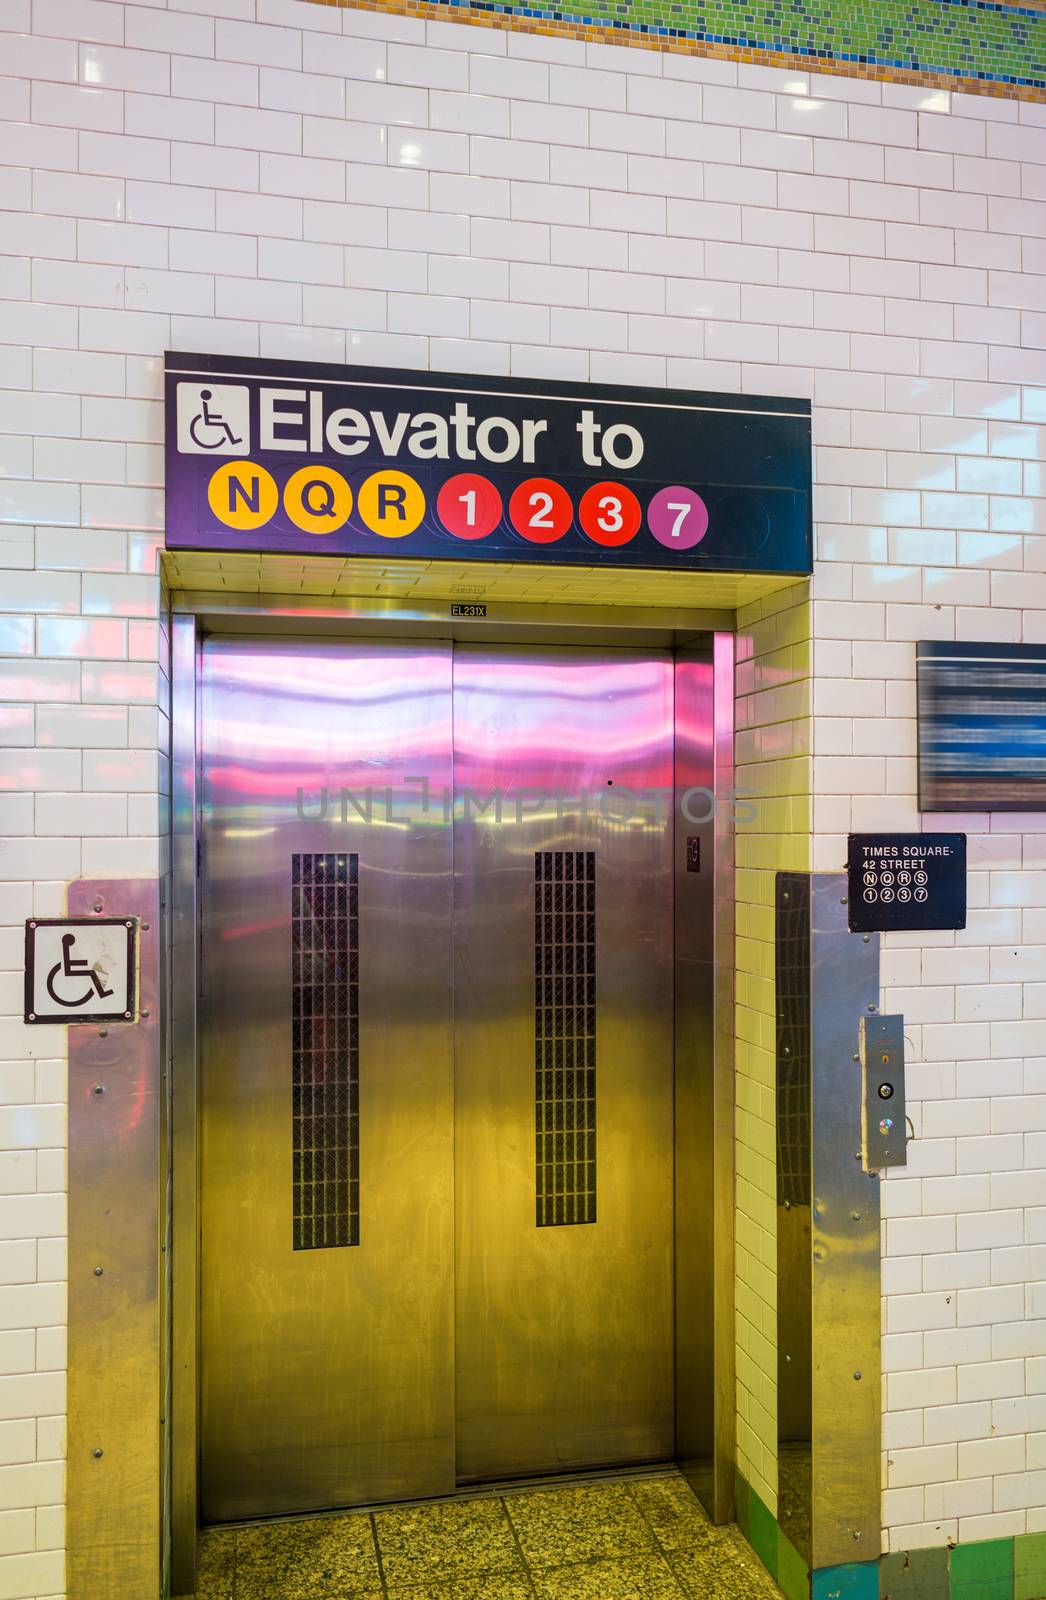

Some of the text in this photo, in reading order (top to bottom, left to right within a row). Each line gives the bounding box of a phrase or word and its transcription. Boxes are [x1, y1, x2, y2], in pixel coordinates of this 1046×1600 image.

[260, 387, 644, 470] Elevator to
[228, 475, 692, 537] N Q R 1 2 3 7
[452, 605, 485, 616] EL231X
[862, 846, 954, 856] TIMES SQUARE-
[862, 860, 926, 869] 42 STREET
[866, 873, 925, 884] N Q R S
[884, 890, 892, 900] 2
[900, 890, 908, 900] 3
[917, 890, 925, 900] 7
